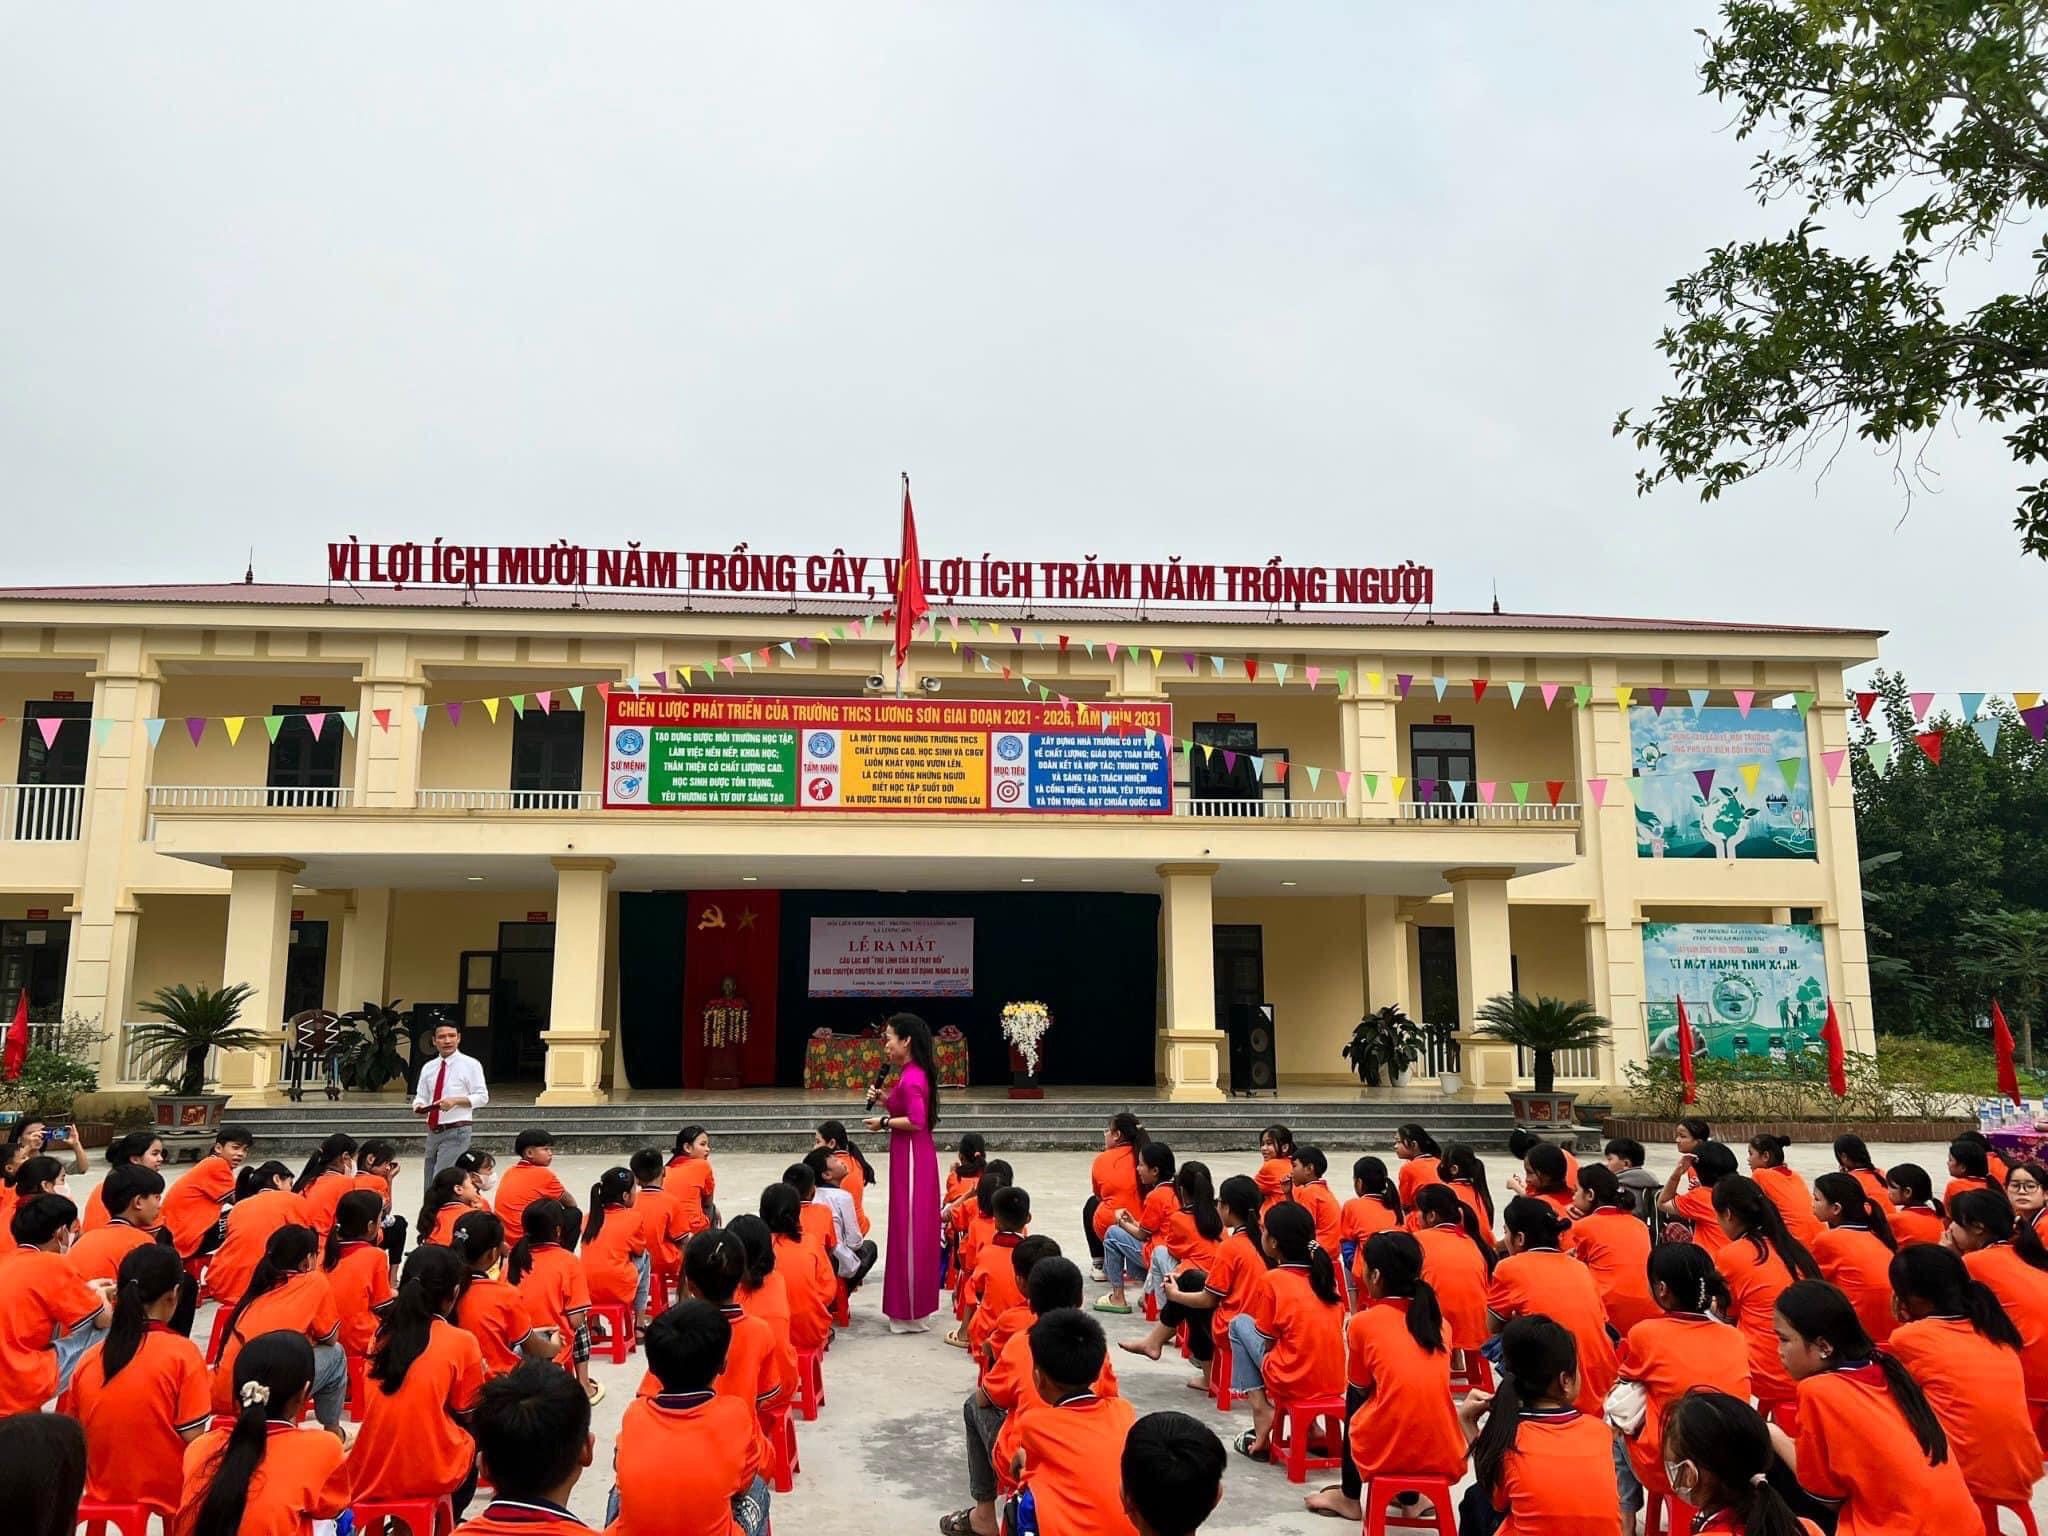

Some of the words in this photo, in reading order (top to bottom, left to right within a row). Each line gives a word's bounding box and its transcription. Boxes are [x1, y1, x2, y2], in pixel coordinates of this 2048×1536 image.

[328, 535, 359, 581] VÌ
[369, 542, 422, 591] LỢI
[432, 537, 488, 584] ÍCH
[500, 539, 587, 586] MƯỜI
[598, 540, 677, 588] NĂM
[686, 542, 796, 592] TRỒNG
[806, 548, 875, 600] CÂY,
[922, 557, 971, 604] LỢI
[980, 553, 1033, 598] ÍCH
[1040, 554, 1131, 599] TRĂM
[1141, 555, 1215, 599] NĂM
[1223, 555, 1327, 603] TRỒNG
[1335, 560, 1433, 604] NGƯỜI
[618, 696, 655, 718] CHIẾN
[658, 700, 690, 721] LƯỢC
[693, 699, 724, 719] PHÁT
[727, 698, 762, 720] TRIỂN
[765, 699, 789, 720] CỦA
[792, 701, 839, 721] TRƯỜNG
[842, 706, 872, 722] THCS
[874, 704, 913, 723] LƯƠNG
[916, 705, 940, 723] SƠN
[943, 707, 967, 724] GIAI
[1004, 709, 1031, 725] 2021
[1043, 710, 1074, 727] 2026,
[1134, 711, 1160, 727] 2031
[848, 936, 869, 951] LỄ
[874, 941, 895, 951] RA
[900, 936, 936, 951] MẮT
